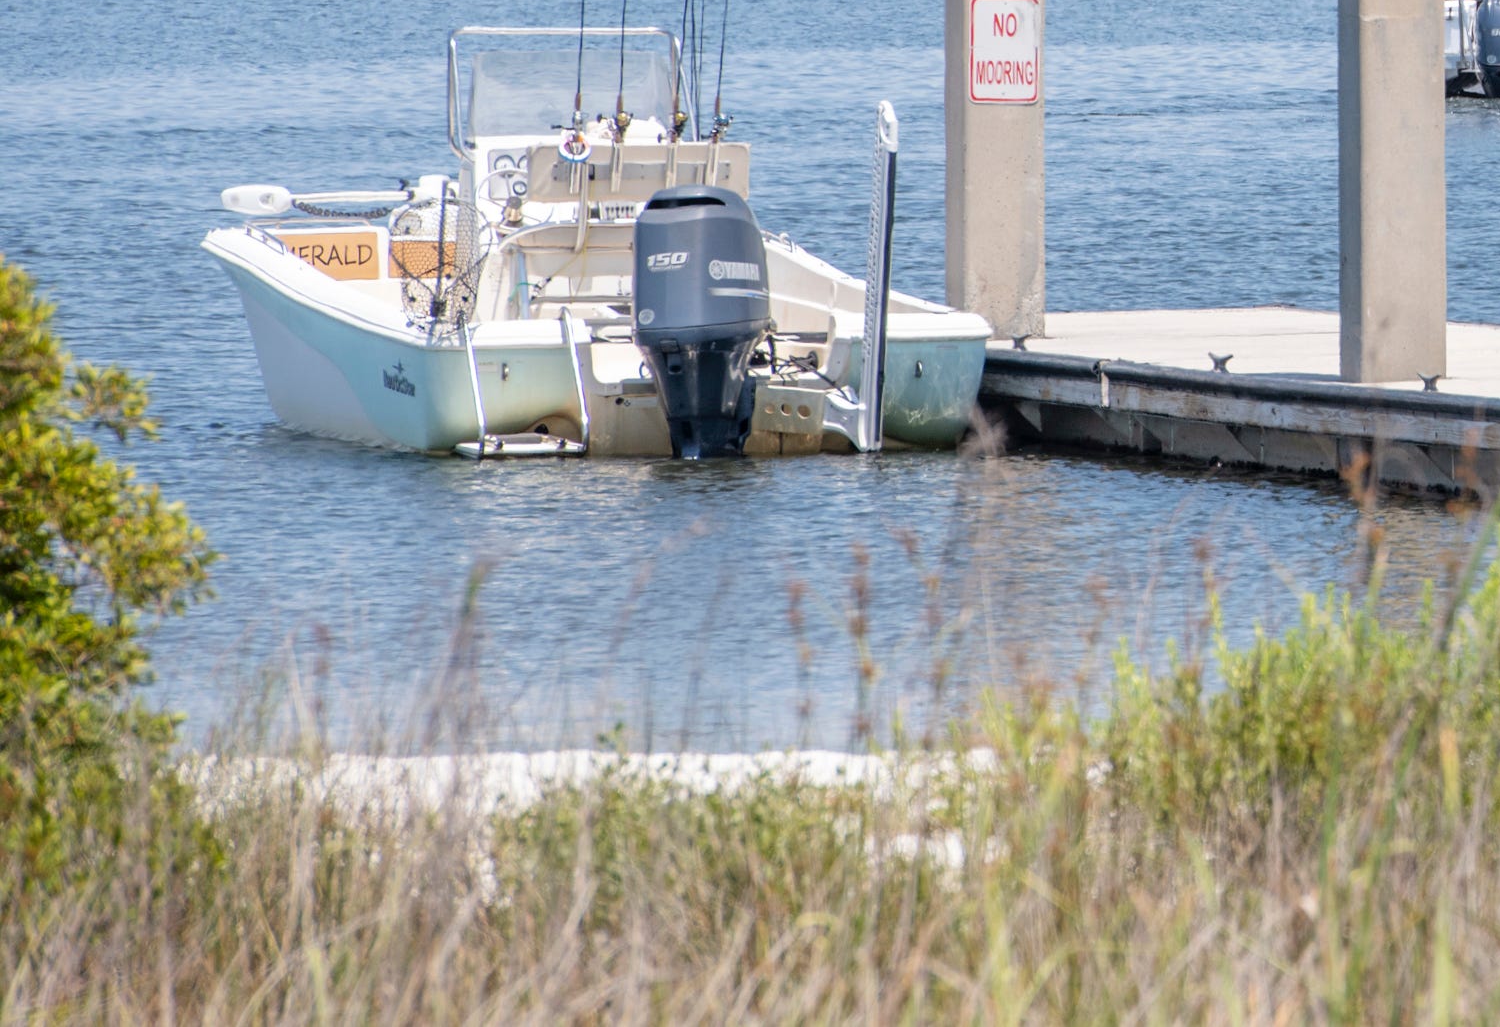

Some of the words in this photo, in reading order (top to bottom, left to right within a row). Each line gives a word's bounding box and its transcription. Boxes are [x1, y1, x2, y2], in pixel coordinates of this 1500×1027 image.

[993, 12, 1018, 38] NO
[975, 60, 1034, 86] MOORING
[291, 244, 373, 266] ERALD
[646, 251, 690, 267] 150
